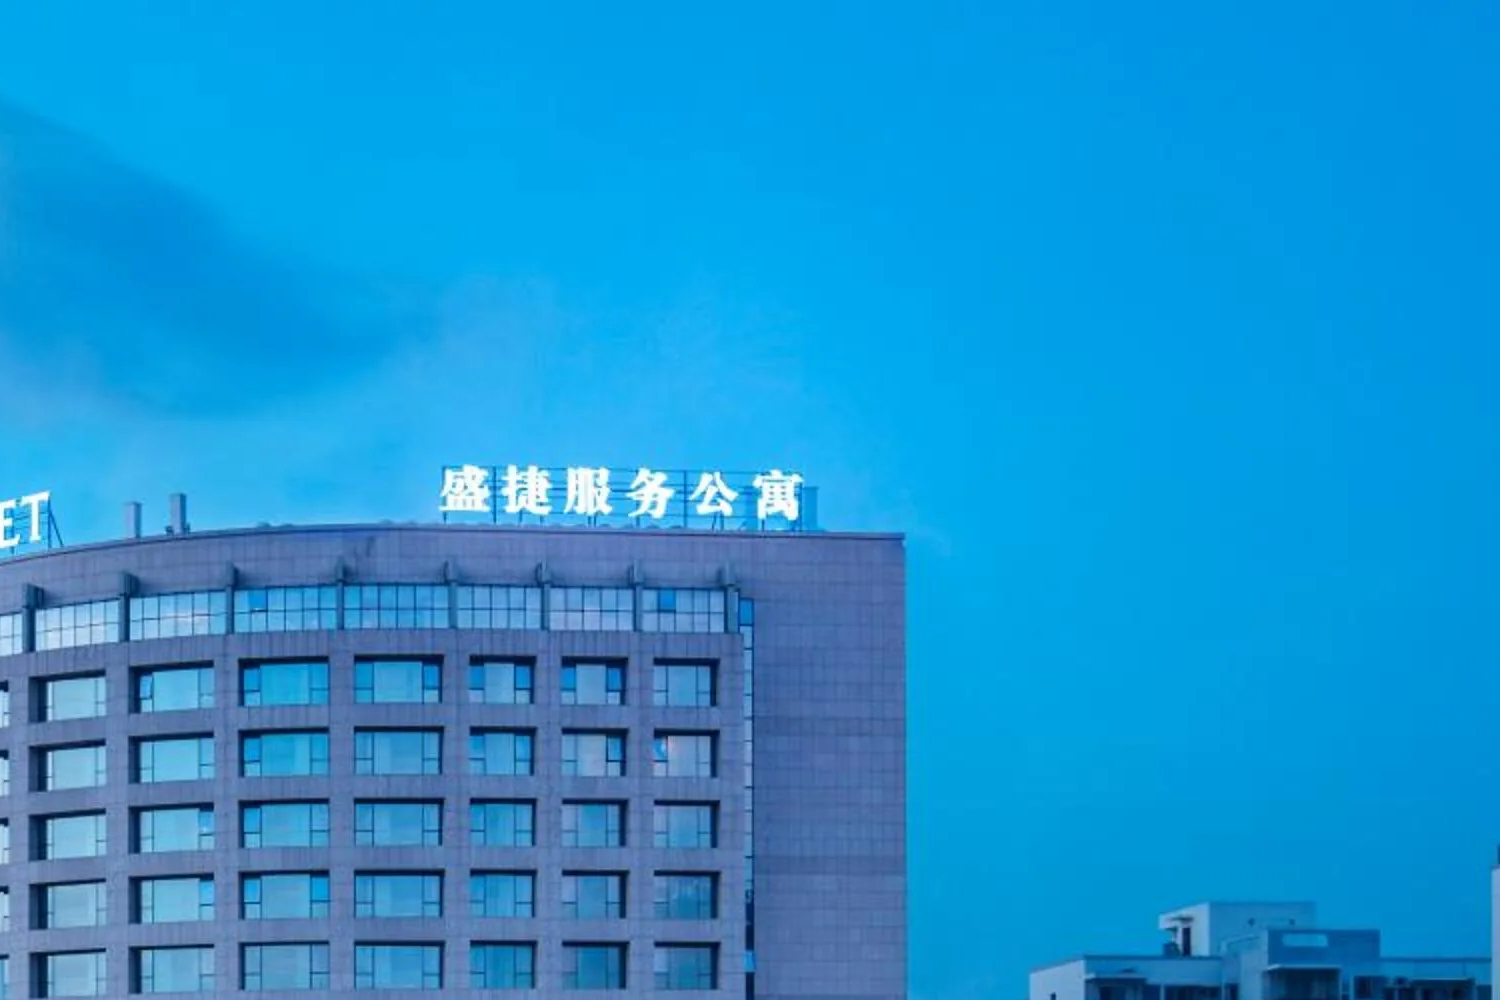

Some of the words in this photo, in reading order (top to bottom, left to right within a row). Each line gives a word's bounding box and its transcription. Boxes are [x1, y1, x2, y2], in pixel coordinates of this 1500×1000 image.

[439, 464, 803, 521] 盛捷服务公寓
